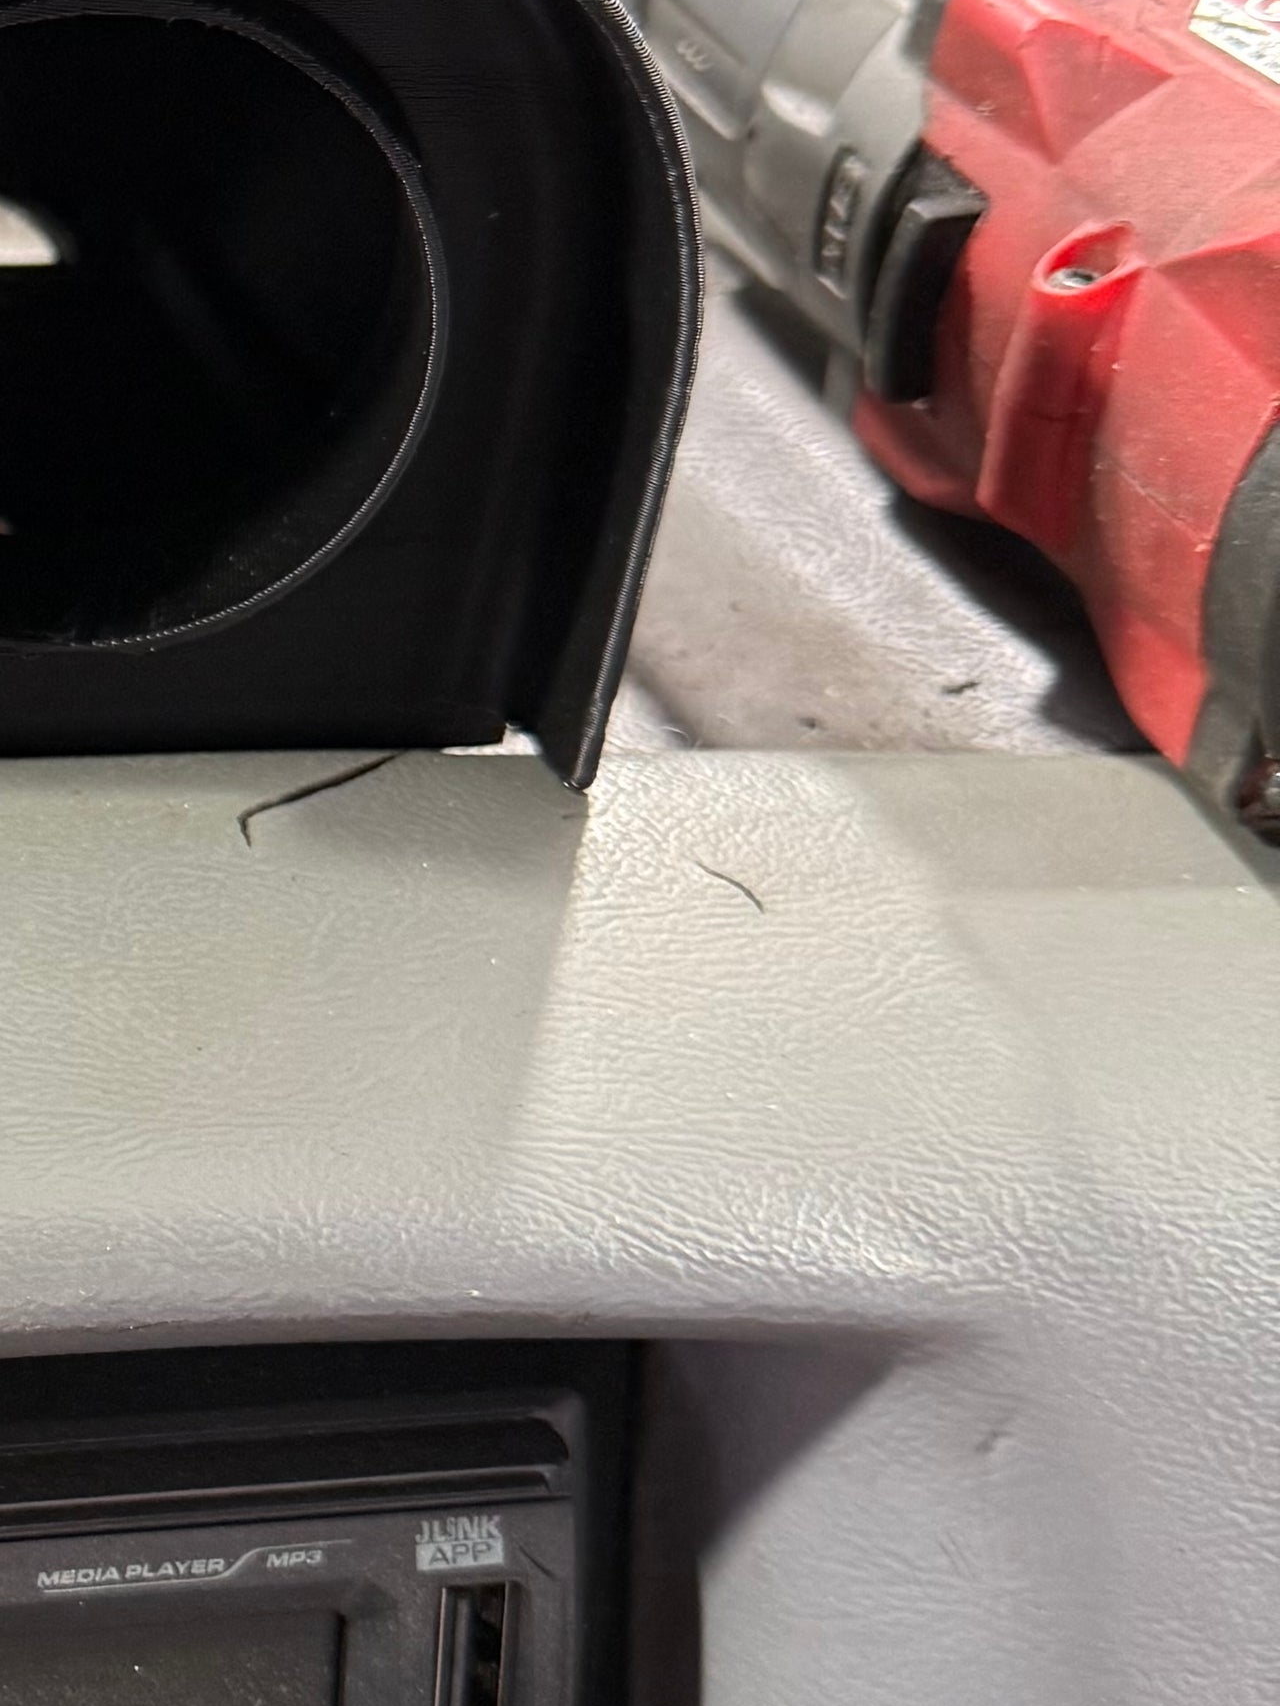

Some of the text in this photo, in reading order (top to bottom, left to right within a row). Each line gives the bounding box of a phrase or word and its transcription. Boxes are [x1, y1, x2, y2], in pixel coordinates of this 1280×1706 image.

[266, 1549, 323, 1569] MP3
[428, 1541, 493, 1566] APP
[37, 1557, 224, 1588] MEDIA PLAYER
